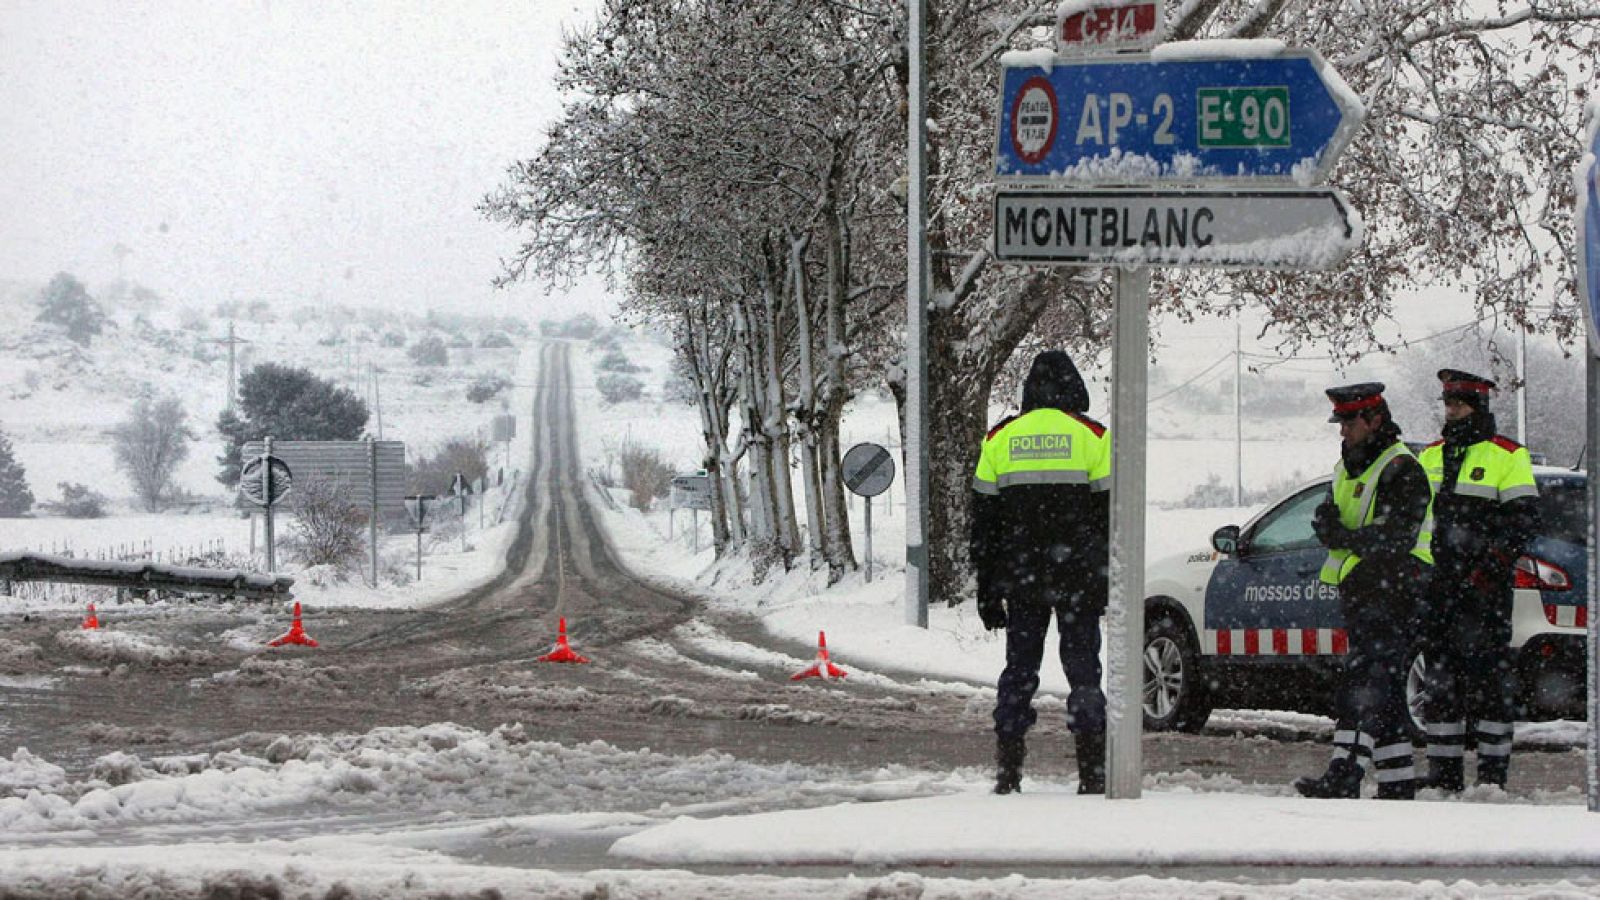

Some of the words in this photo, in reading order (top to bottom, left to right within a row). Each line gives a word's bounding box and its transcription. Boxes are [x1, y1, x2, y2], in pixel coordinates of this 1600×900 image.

[1081, 8, 1137, 41] C-14
[1075, 93, 1176, 145] AP-2
[1005, 206, 1214, 248] MONTBLANC
[1011, 435, 1069, 451] POLICIA
[1245, 584, 1301, 602] mossos
